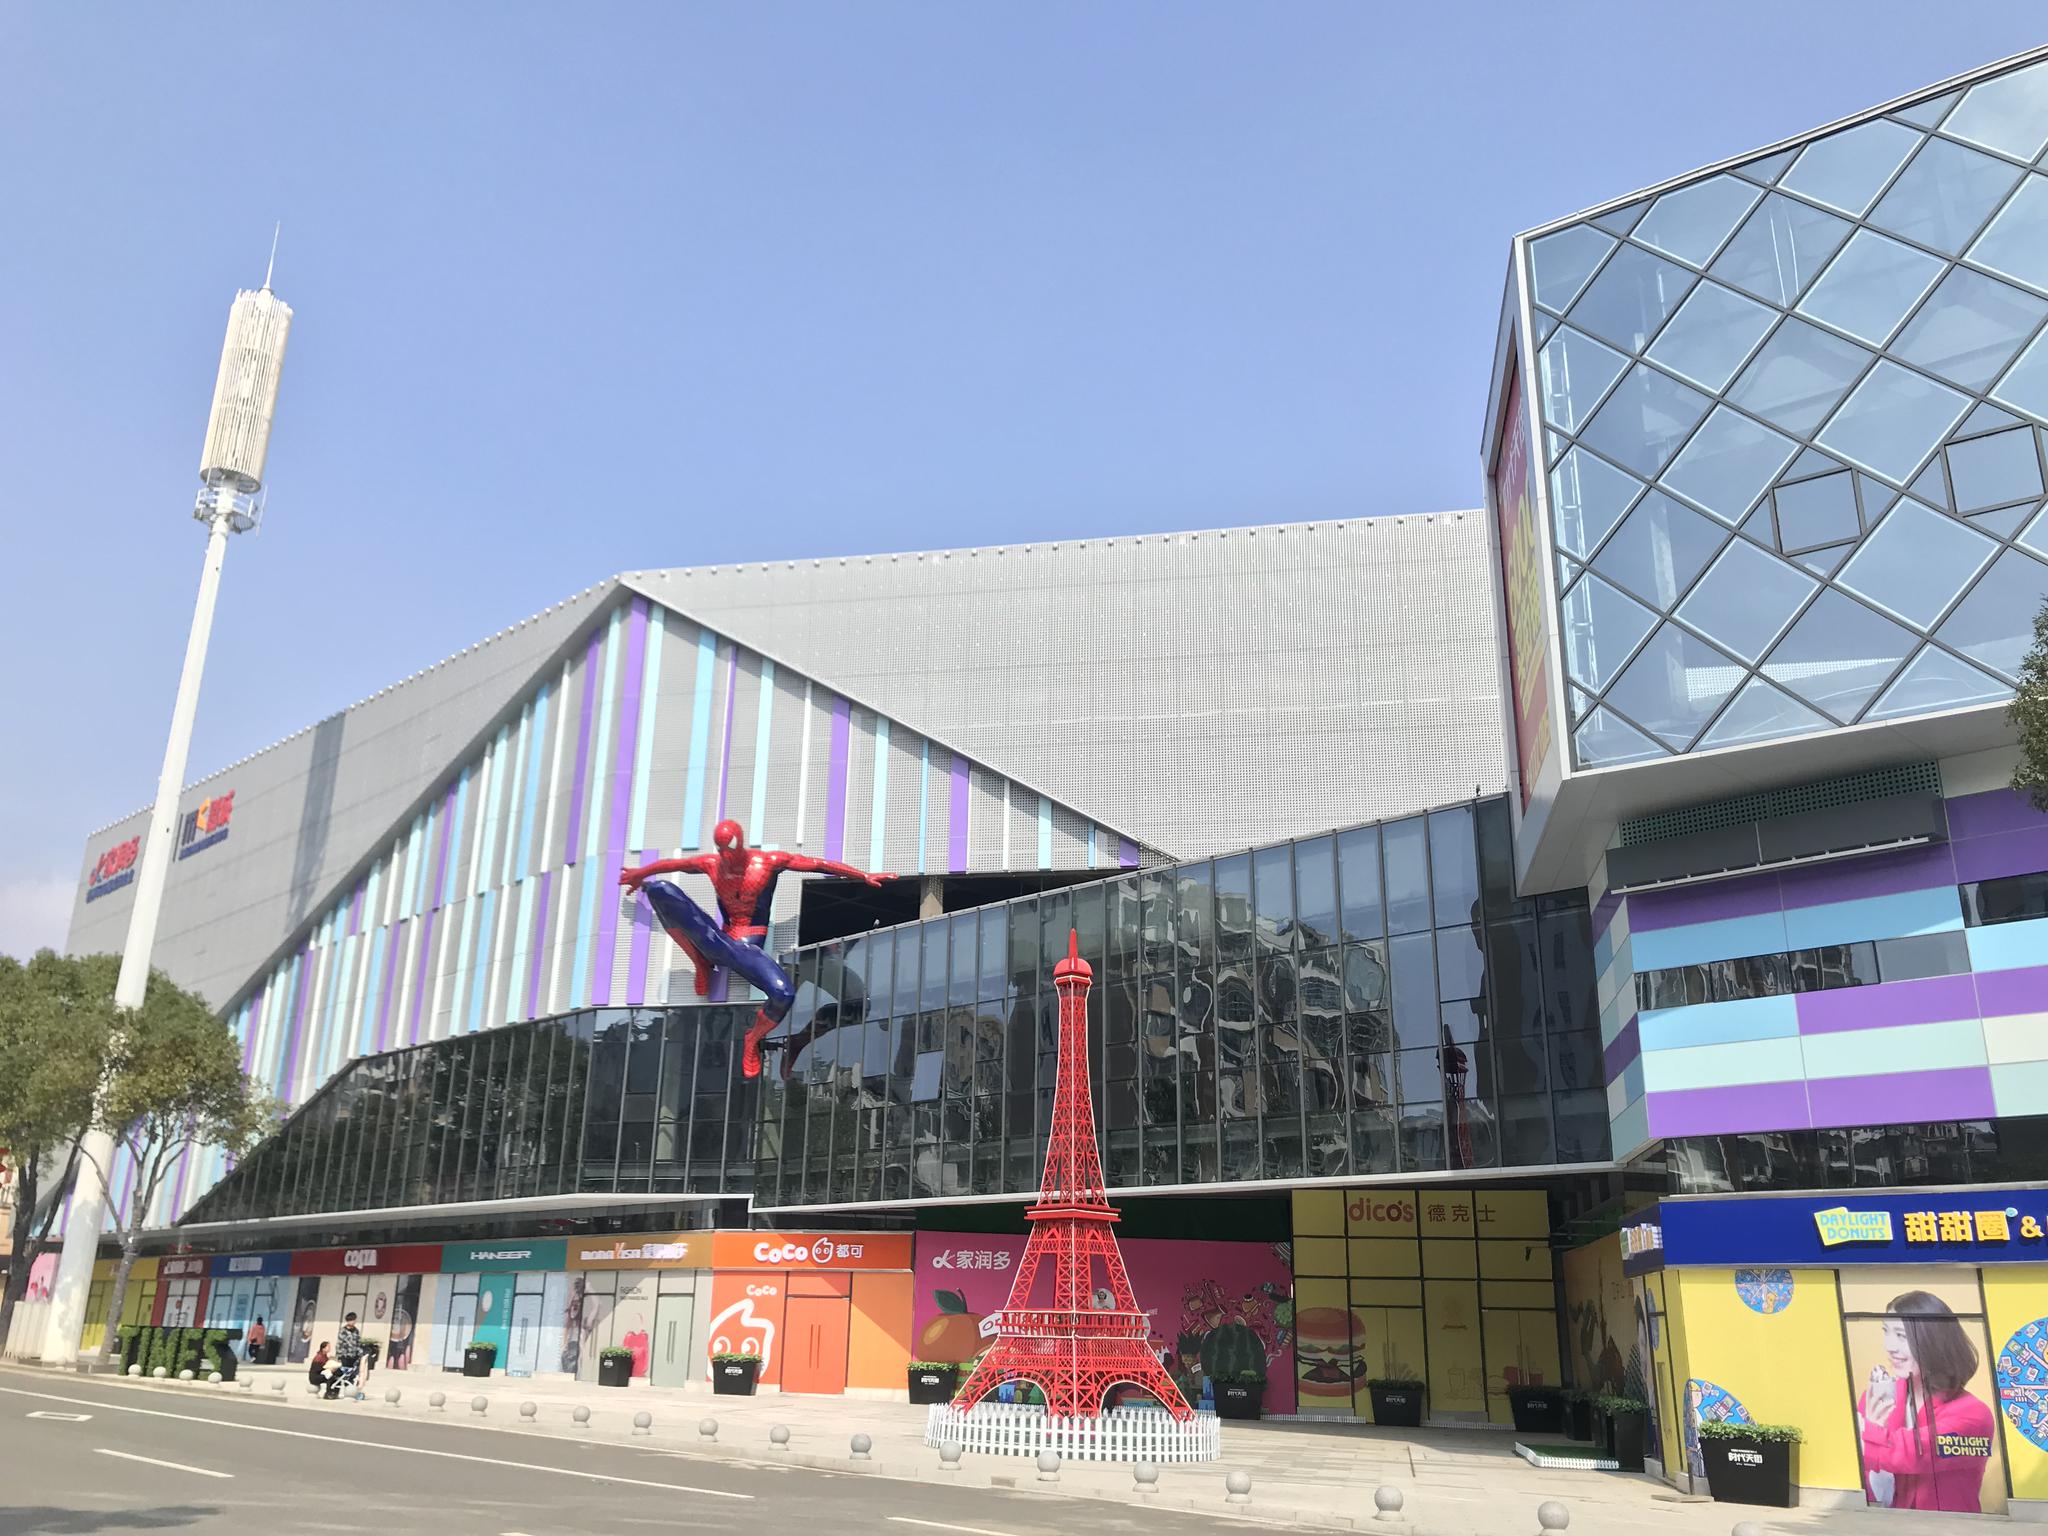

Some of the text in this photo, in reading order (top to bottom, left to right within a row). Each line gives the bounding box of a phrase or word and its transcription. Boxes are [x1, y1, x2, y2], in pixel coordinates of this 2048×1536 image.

[1427, 1204, 1497, 1223] 德克士
[1820, 1212, 1888, 1226] DAYLIGHT
[1827, 1226, 1886, 1240] DONUTS
[1904, 1210, 2045, 1242] 甜甜圈 &
[836, 1244, 864, 1258] 都可
[956, 1250, 1011, 1270] 家润多
[1937, 1435, 1990, 1446] DAYLIGHT
[1943, 1446, 1989, 1457] DONUTS
